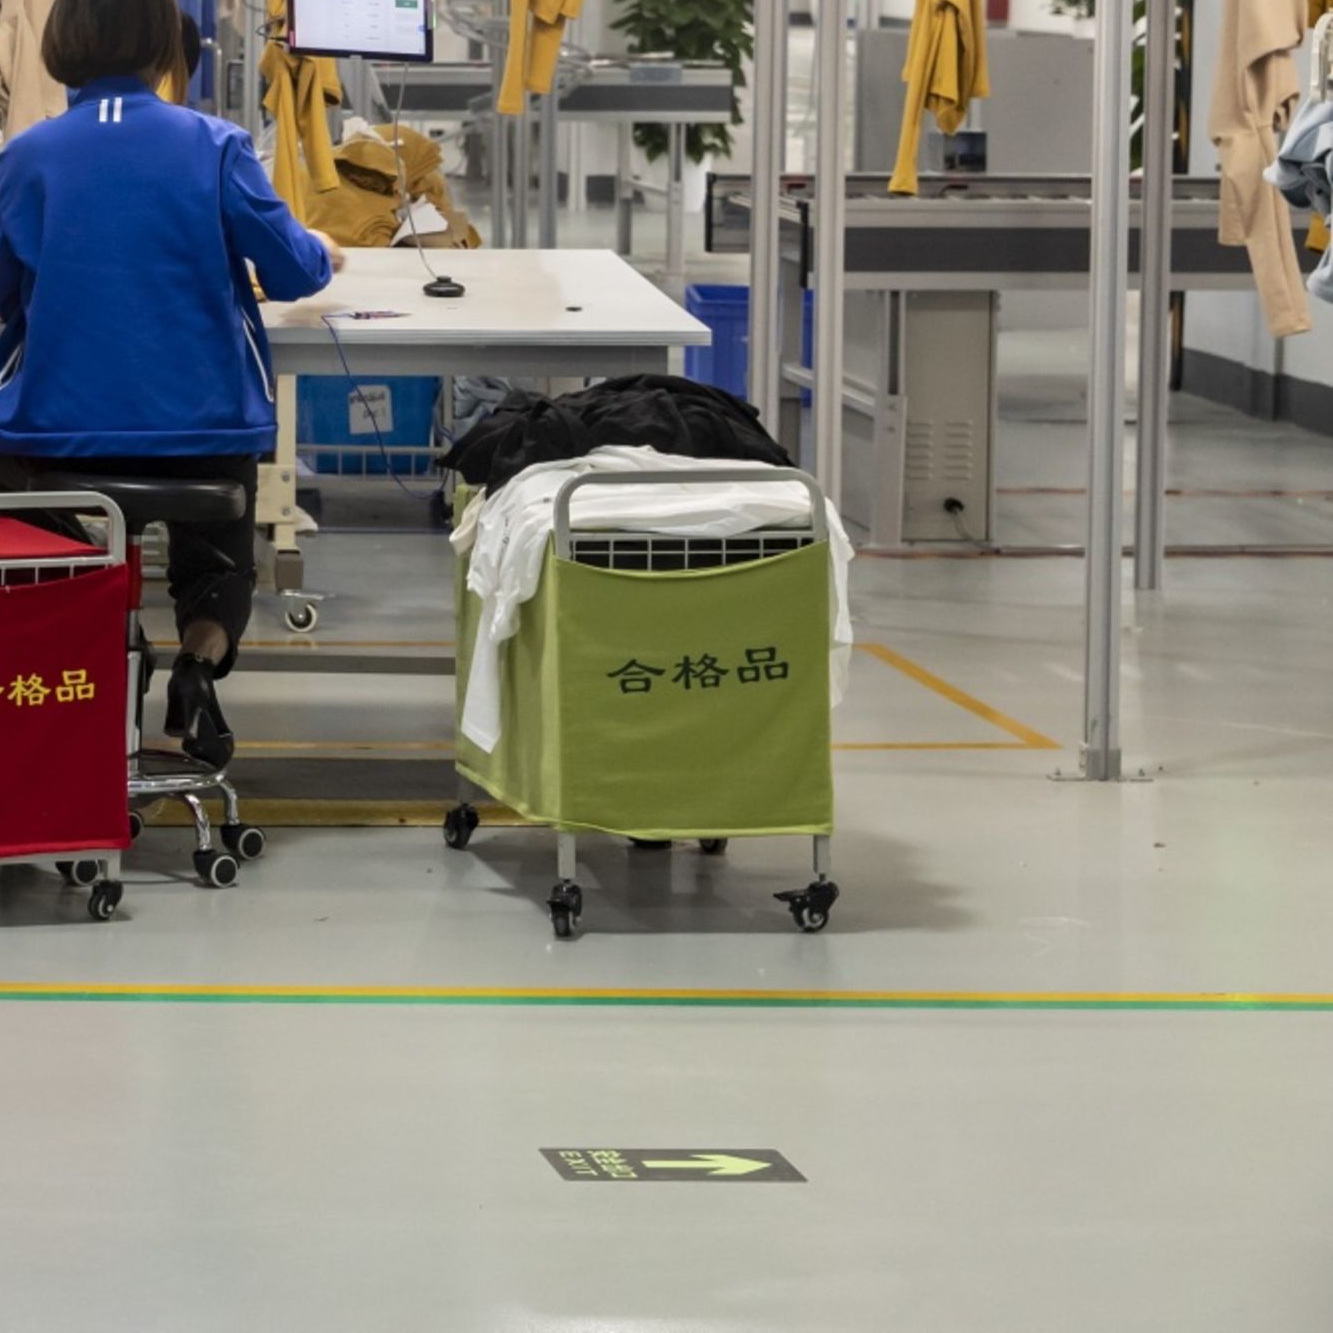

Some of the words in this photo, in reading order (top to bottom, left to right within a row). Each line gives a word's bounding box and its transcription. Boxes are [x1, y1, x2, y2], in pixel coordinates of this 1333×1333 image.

[607, 645, 791, 695] 合格品
[558, 1151, 598, 1176] EXIT
